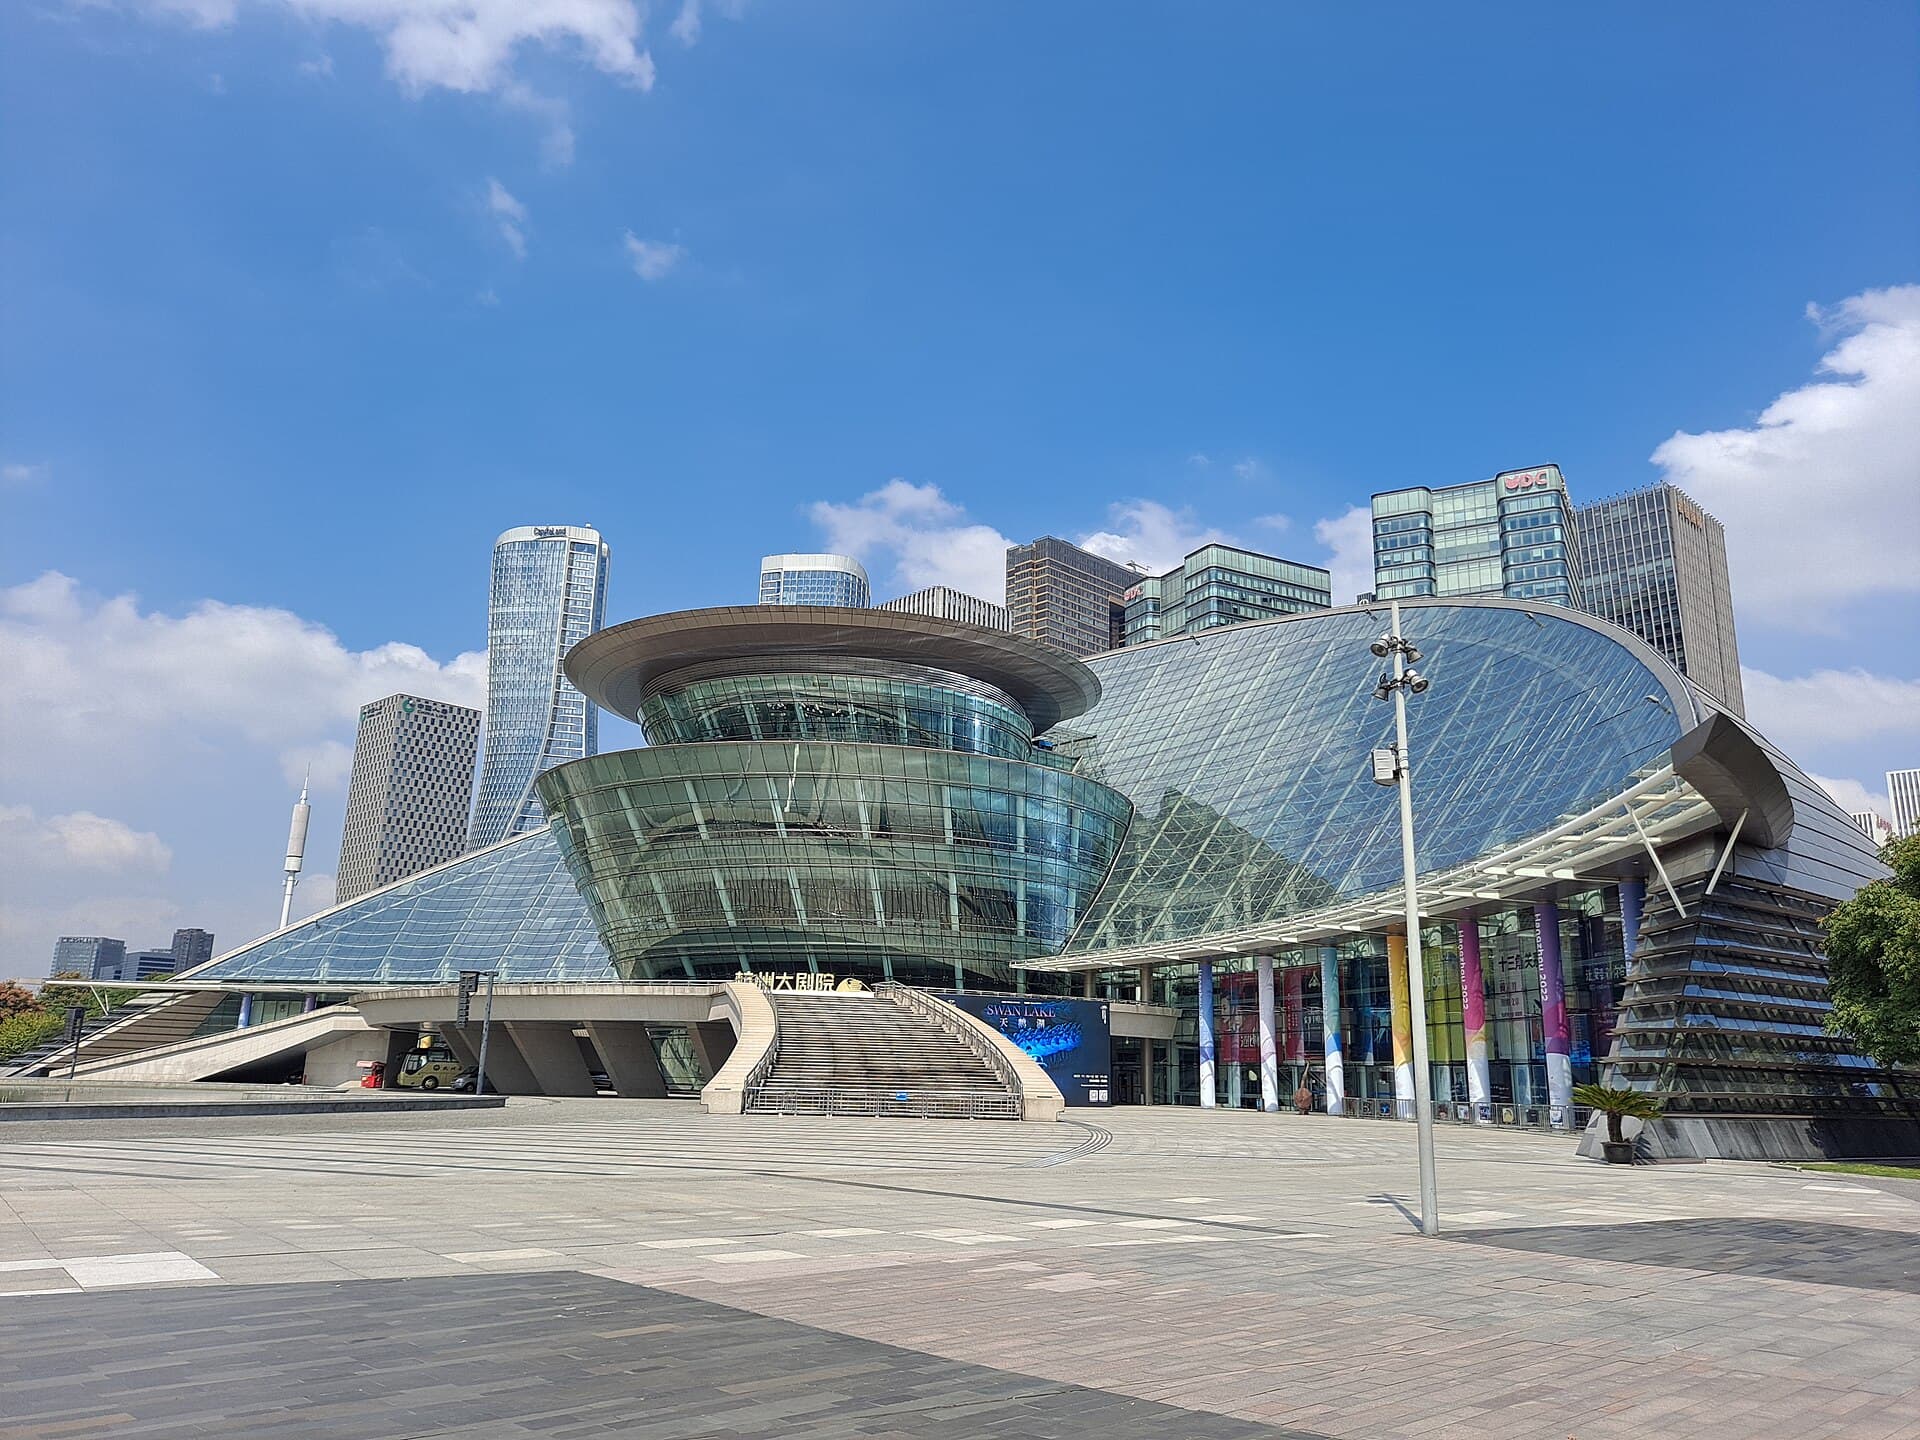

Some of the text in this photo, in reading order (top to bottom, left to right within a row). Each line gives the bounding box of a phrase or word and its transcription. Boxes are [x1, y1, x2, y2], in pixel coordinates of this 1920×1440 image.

[1534, 913, 1549, 1002] Hangzhou 2022
[986, 1004, 1056, 1018] SWAN LAKE
